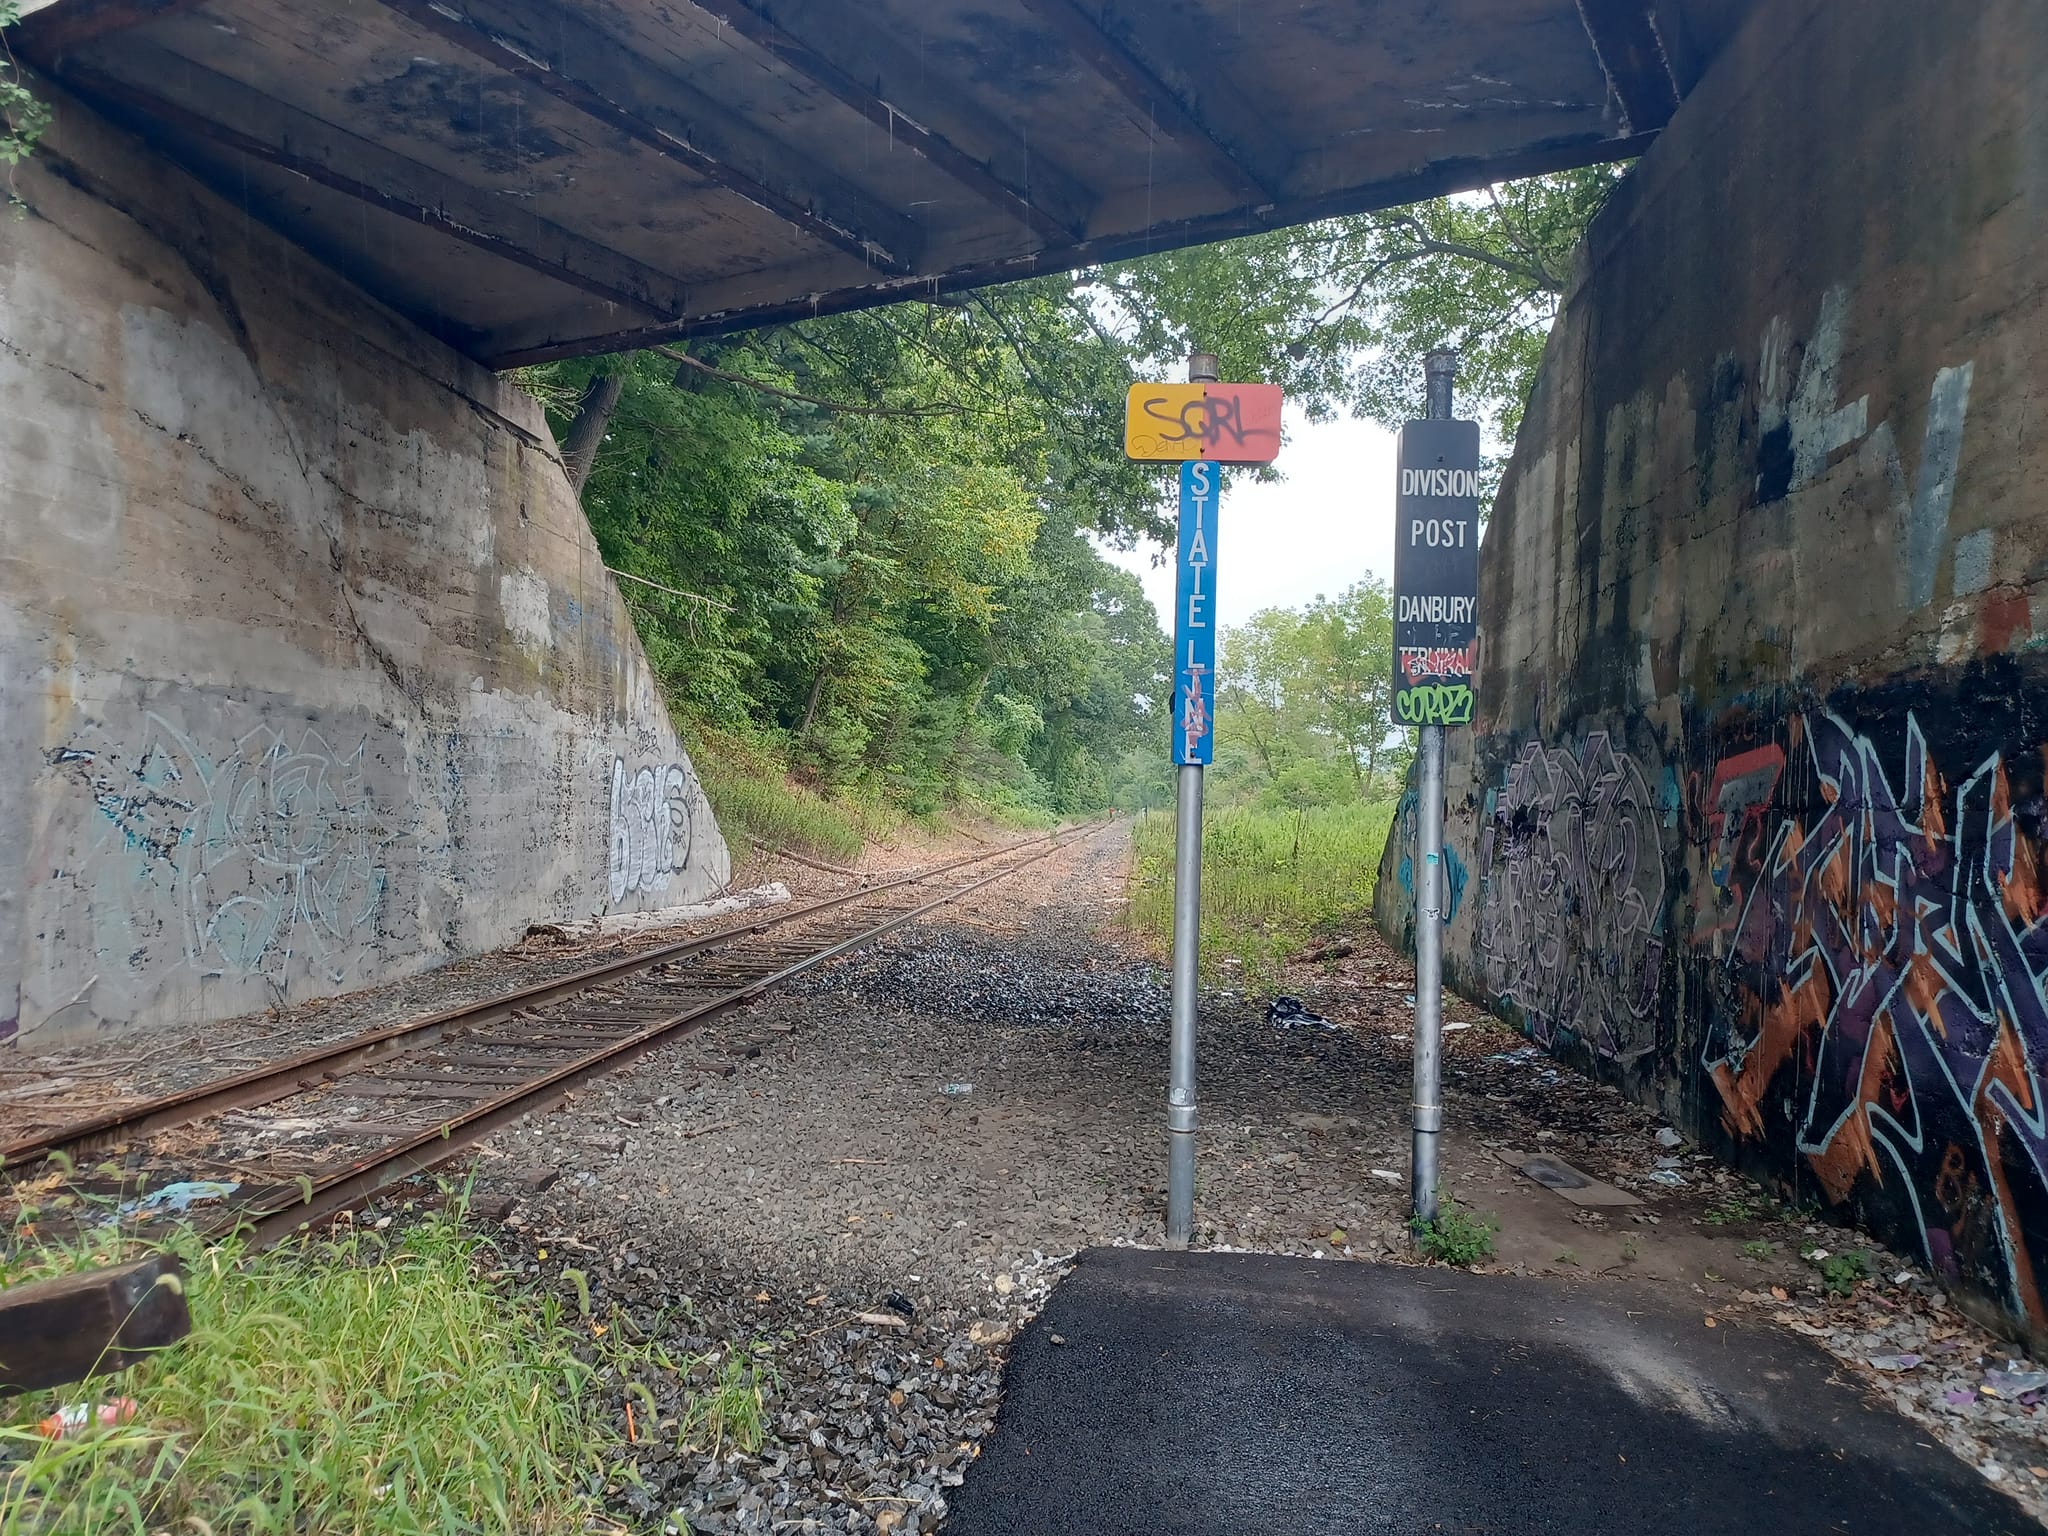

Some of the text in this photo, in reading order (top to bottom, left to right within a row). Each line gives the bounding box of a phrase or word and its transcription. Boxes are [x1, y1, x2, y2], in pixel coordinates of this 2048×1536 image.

[1402, 468, 1479, 497] DIVISION
[1411, 519, 1467, 548] POST
[1185, 463, 1210, 764] STATE LINE
[1399, 596, 1475, 623] DANBURY
